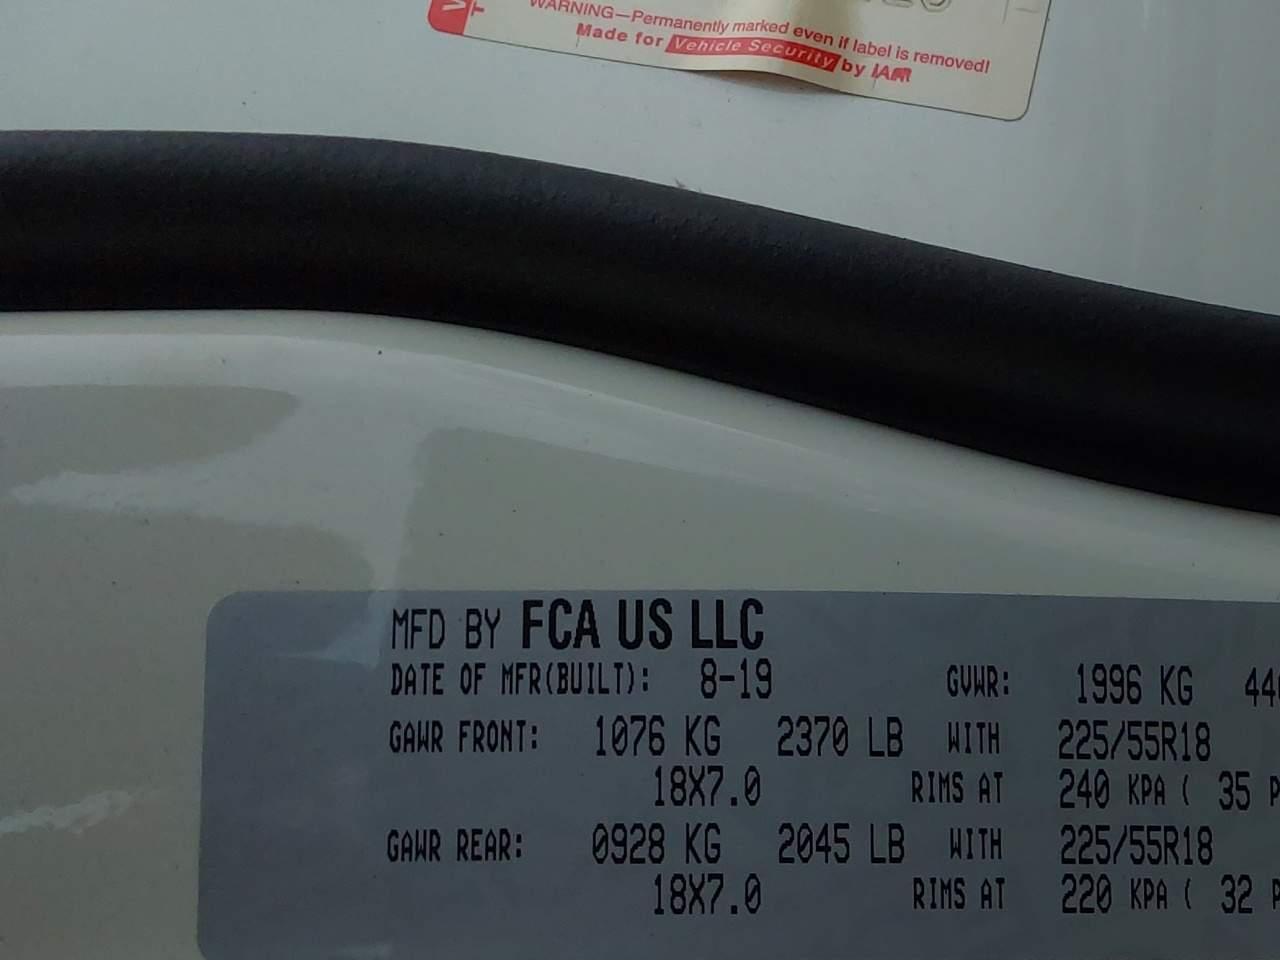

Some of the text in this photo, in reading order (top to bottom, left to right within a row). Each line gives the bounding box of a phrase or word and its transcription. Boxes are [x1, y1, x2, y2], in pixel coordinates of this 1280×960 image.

[575, 23, 629, 43] Made
[634, 33, 664, 47] for
[674, 36, 741, 50] Vehicle
[749, 39, 834, 68] Security
[840, 58, 866, 79] by
[732, 20, 789, 34] marked
[793, 25, 833, 46] even
[838, 35, 849, 49] if
[852, 39, 892, 58] label
[896, 44, 909, 60] is
[912, 51, 990, 74] removed!
[392, 598, 763, 650] MFD BY FCA US LLC
[391, 658, 771, 699] DATE OF MFR(BUILT): 8-19
[947, 665, 1008, 697] GVWR:
[1078, 664, 1141, 704] 1996
[1161, 665, 1192, 705] KG
[390, 720, 443, 753] GAWR
[459, 720, 537, 752] FRONT:
[597, 715, 664, 756] 1076
[686, 715, 720, 756] KG
[778, 716, 848, 756] 2370
[869, 717, 903, 757] LB
[948, 722, 999, 754] WITH
[1059, 719, 1210, 761] 225/55R18
[655, 765, 760, 806] 18X7.0
[912, 771, 963, 803] RIMS
[979, 772, 1002, 803] AT
[1060, 768, 1109, 809] 240
[1129, 774, 1165, 805] KPA
[1183, 775, 1189, 805] (
[1219, 771, 1250, 810] 35
[387, 829, 440, 862] GAWR
[457, 828, 521, 861] REAR:
[593, 823, 664, 864] 0928
[686, 823, 720, 864] KG
[779, 823, 849, 863] 2045
[871, 823, 904, 863] LB
[950, 828, 1002, 859] WITH
[1061, 825, 1212, 865] 225/55R18
[654, 873, 761, 915] 18X7.0
[914, 877, 965, 909] RIMS
[981, 878, 1005, 909] AT
[1062, 873, 1112, 913] 220
[1131, 878, 1167, 909] KPA
[1185, 878, 1191, 909] (
[1221, 874, 1252, 913] 32
